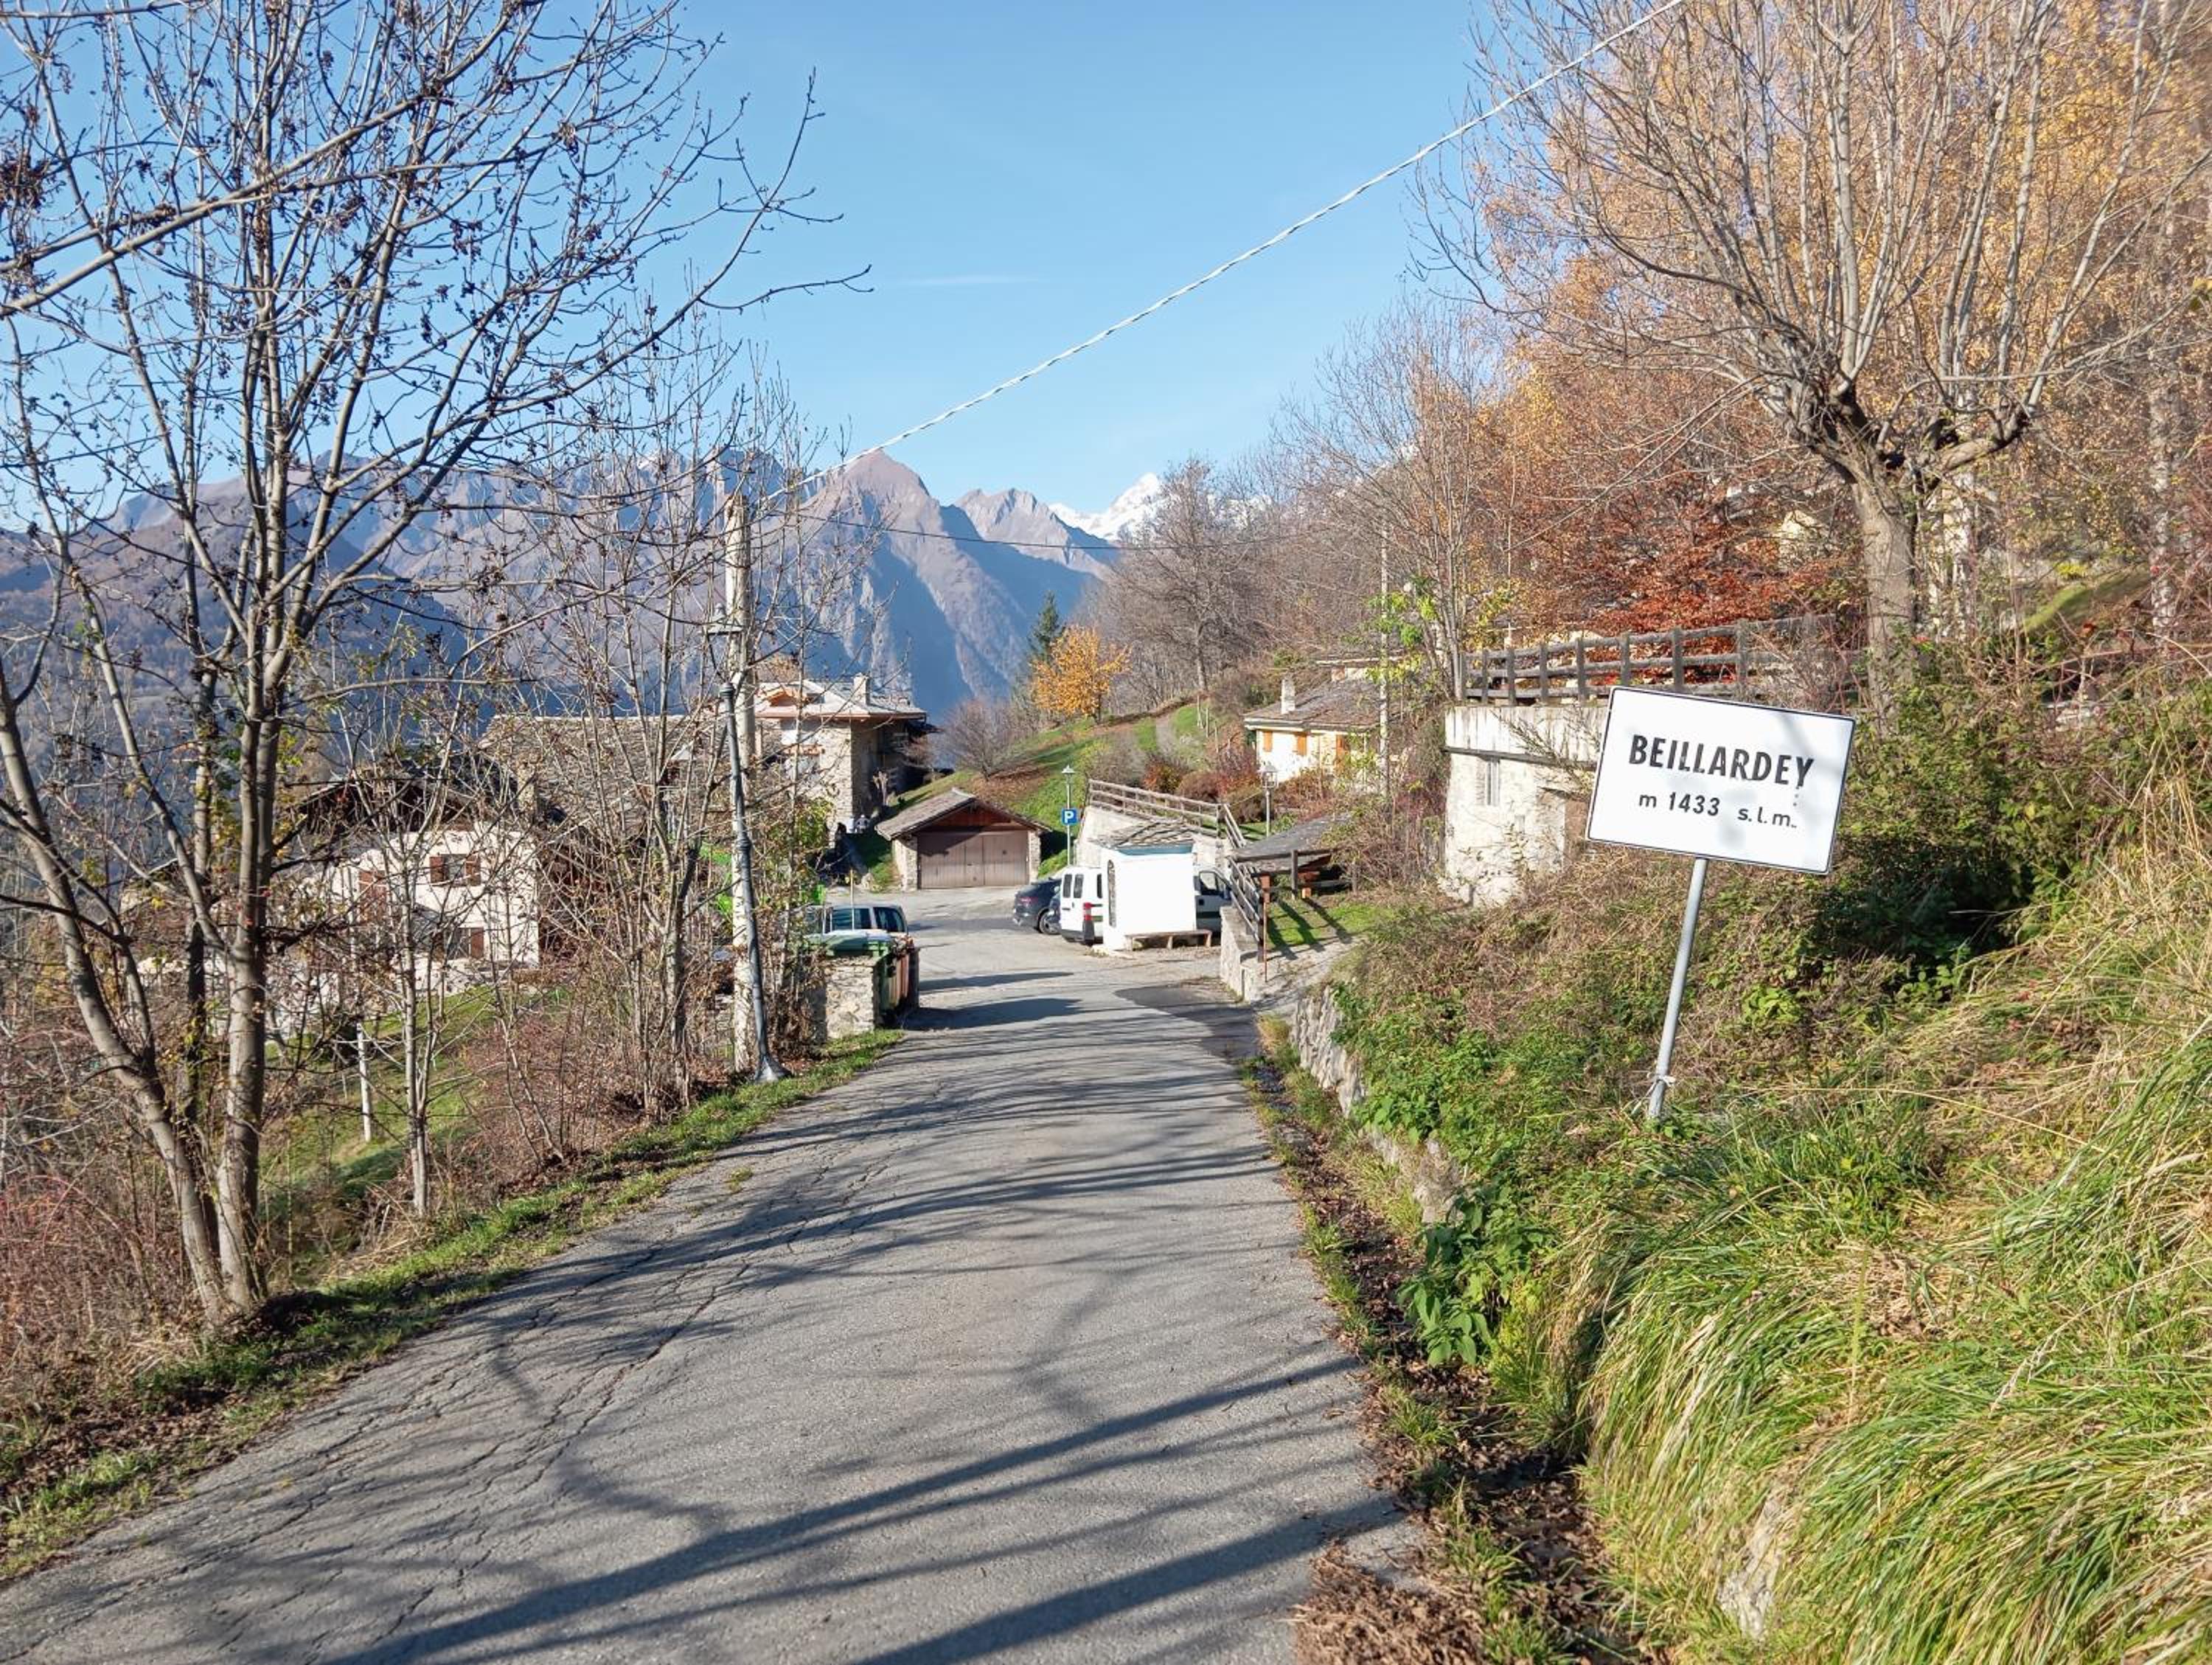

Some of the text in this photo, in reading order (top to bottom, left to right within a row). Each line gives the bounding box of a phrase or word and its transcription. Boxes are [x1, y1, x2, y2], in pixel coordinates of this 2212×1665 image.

[1629, 734, 1815, 788] BEILLARDEY
[1638, 794, 1657, 808] m
[1669, 791, 1720, 816] 1433
[1064, 810, 1074, 824] P
